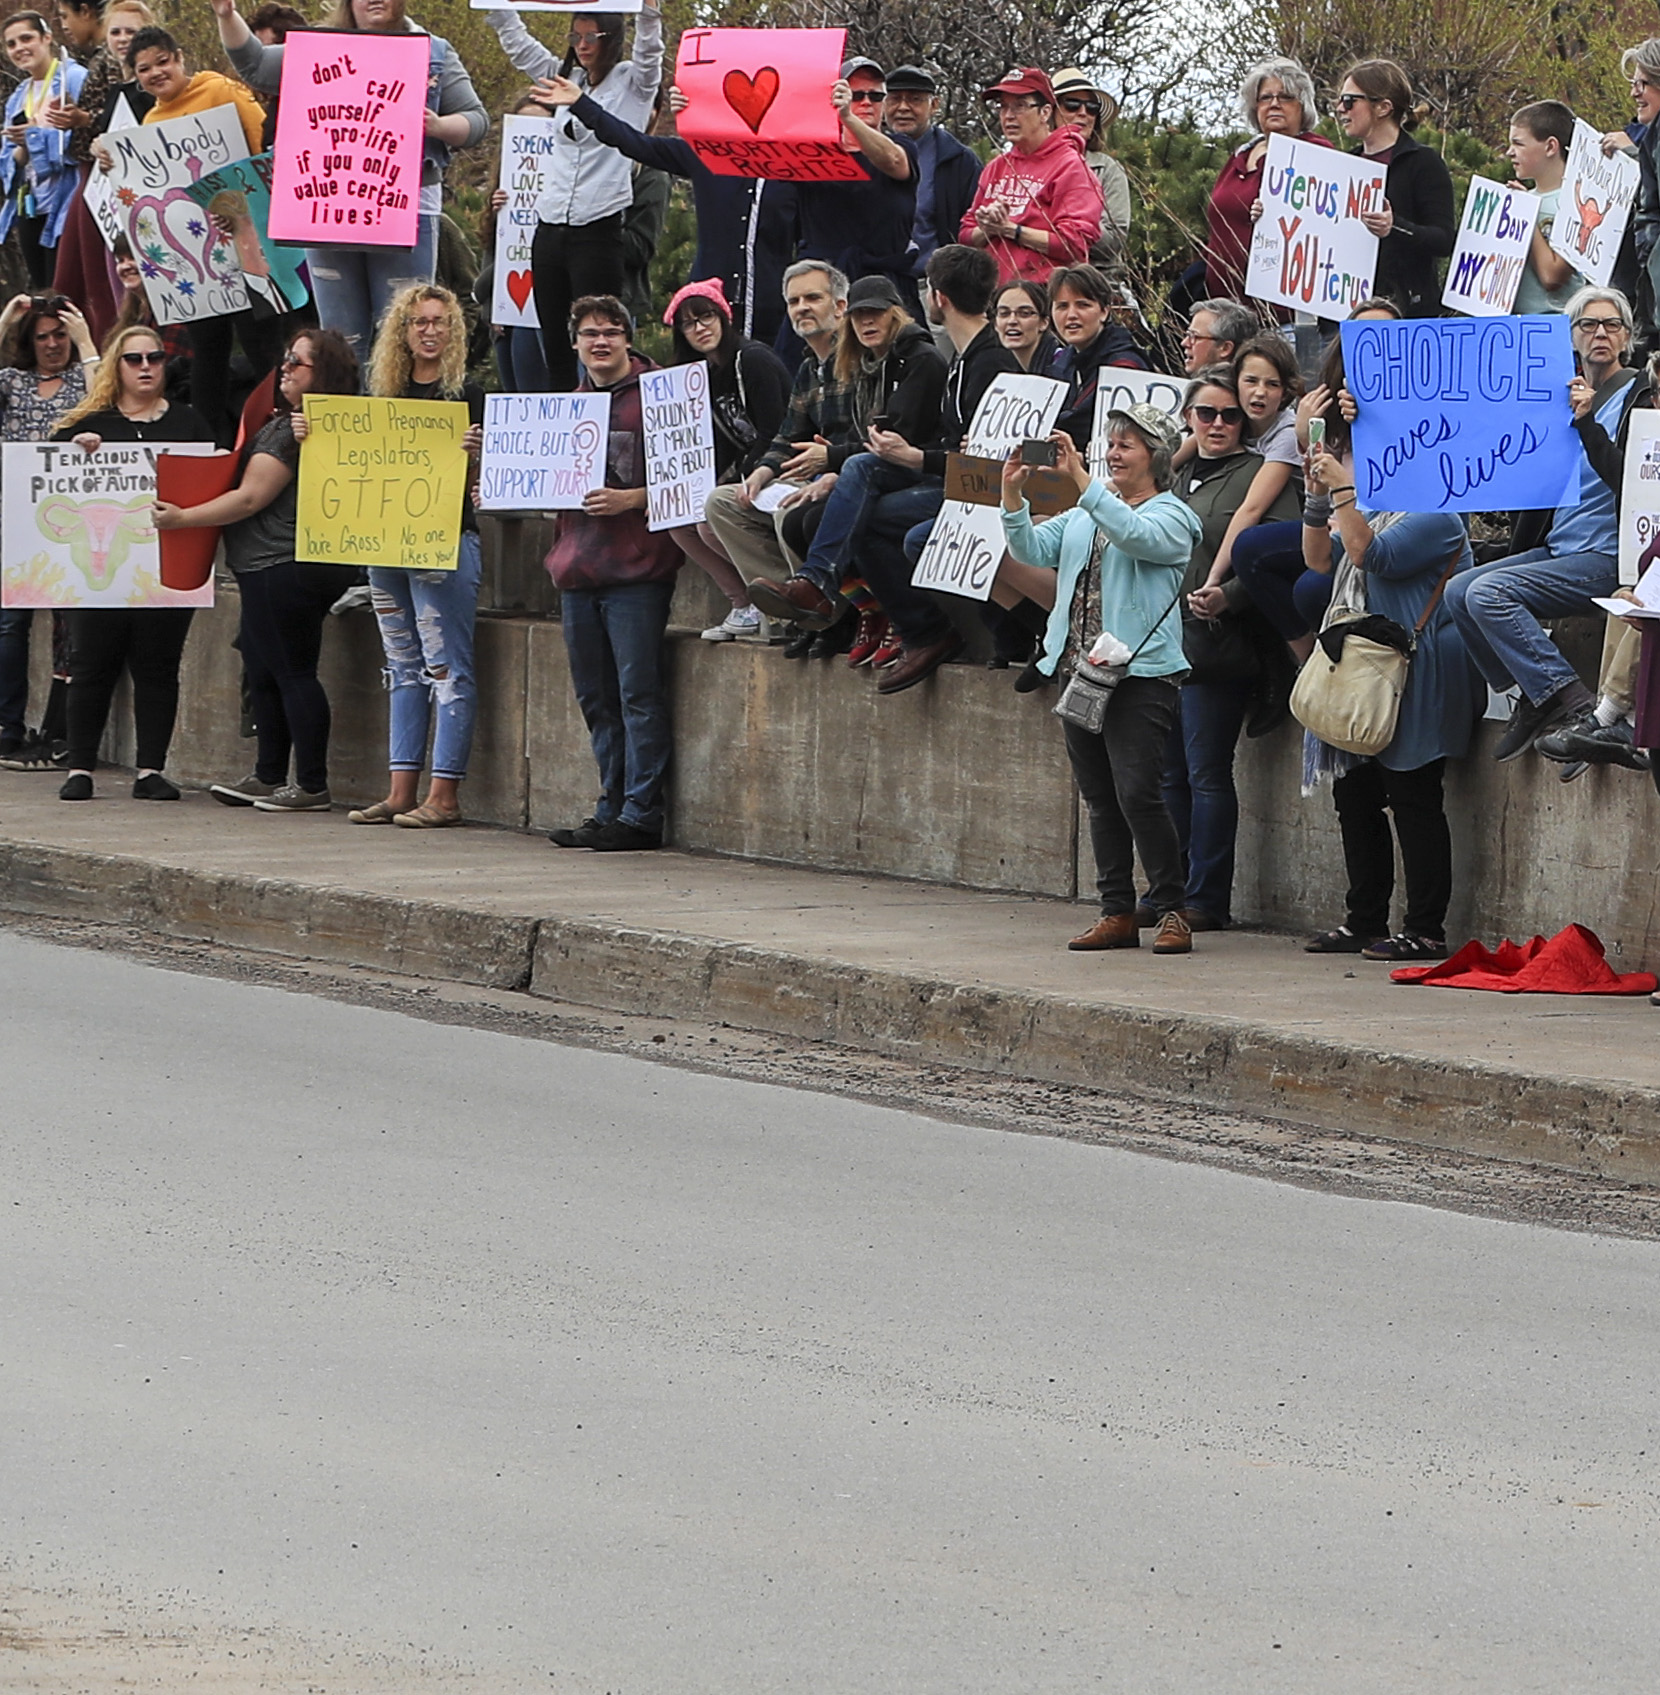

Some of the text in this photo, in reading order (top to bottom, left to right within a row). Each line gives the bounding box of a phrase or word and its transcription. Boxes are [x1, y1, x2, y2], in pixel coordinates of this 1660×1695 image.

[684, 32, 716, 66] I
[312, 55, 357, 85] don't
[366, 80, 405, 103] call
[307, 101, 385, 130] yourself
[115, 136, 170, 188] My
[156, 117, 230, 165] body
[512, 135, 554, 155] SOMEONE
[693, 140, 850, 159] ABORTION
[296, 150, 401, 186] if you only
[517, 155, 539, 171] YOU
[730, 157, 858, 178] RIGHTS
[293, 176, 338, 200] value
[347, 179, 408, 209] certain
[511, 173, 544, 192] LOVE
[514, 192, 539, 208] MAY
[1344, 176, 1383, 220] NOT
[311, 202, 382, 225] lives!
[509, 209, 540, 225] NEED
[1467, 186, 1529, 243] MY BODY
[518, 228, 527, 245] A
[506, 245, 532, 261] CHOI
[1450, 251, 1524, 312] MY CHOICE
[1353, 322, 1552, 402] CHOICE
[643, 373, 674, 402] MEN
[307, 399, 454, 444] Forced Pregnancy
[491, 397, 587, 425] IT'S NOT MY
[971, 383, 1059, 440] Forced
[337, 435, 433, 477] Legislators,
[485, 432, 534, 456] CHOICE,
[540, 431, 570, 456] BUT
[645, 424, 703, 459] BE MAKING
[1367, 413, 1461, 499] saves
[36, 446, 139, 473] TENACIOUS
[83, 467, 122, 476] IN THE
[648, 446, 713, 486] LAWS ABOUT
[1437, 422, 1549, 509] lives
[31, 476, 102, 503] PICK OF
[484, 467, 589, 499] SUPPORT YOURS
[961, 474, 989, 494] FUN
[322, 477, 442, 519] GTFO!
[649, 480, 691, 523] WOMEN
[400, 525, 416, 546] No
[425, 530, 446, 542] one
[401, 549, 428, 565] likes
